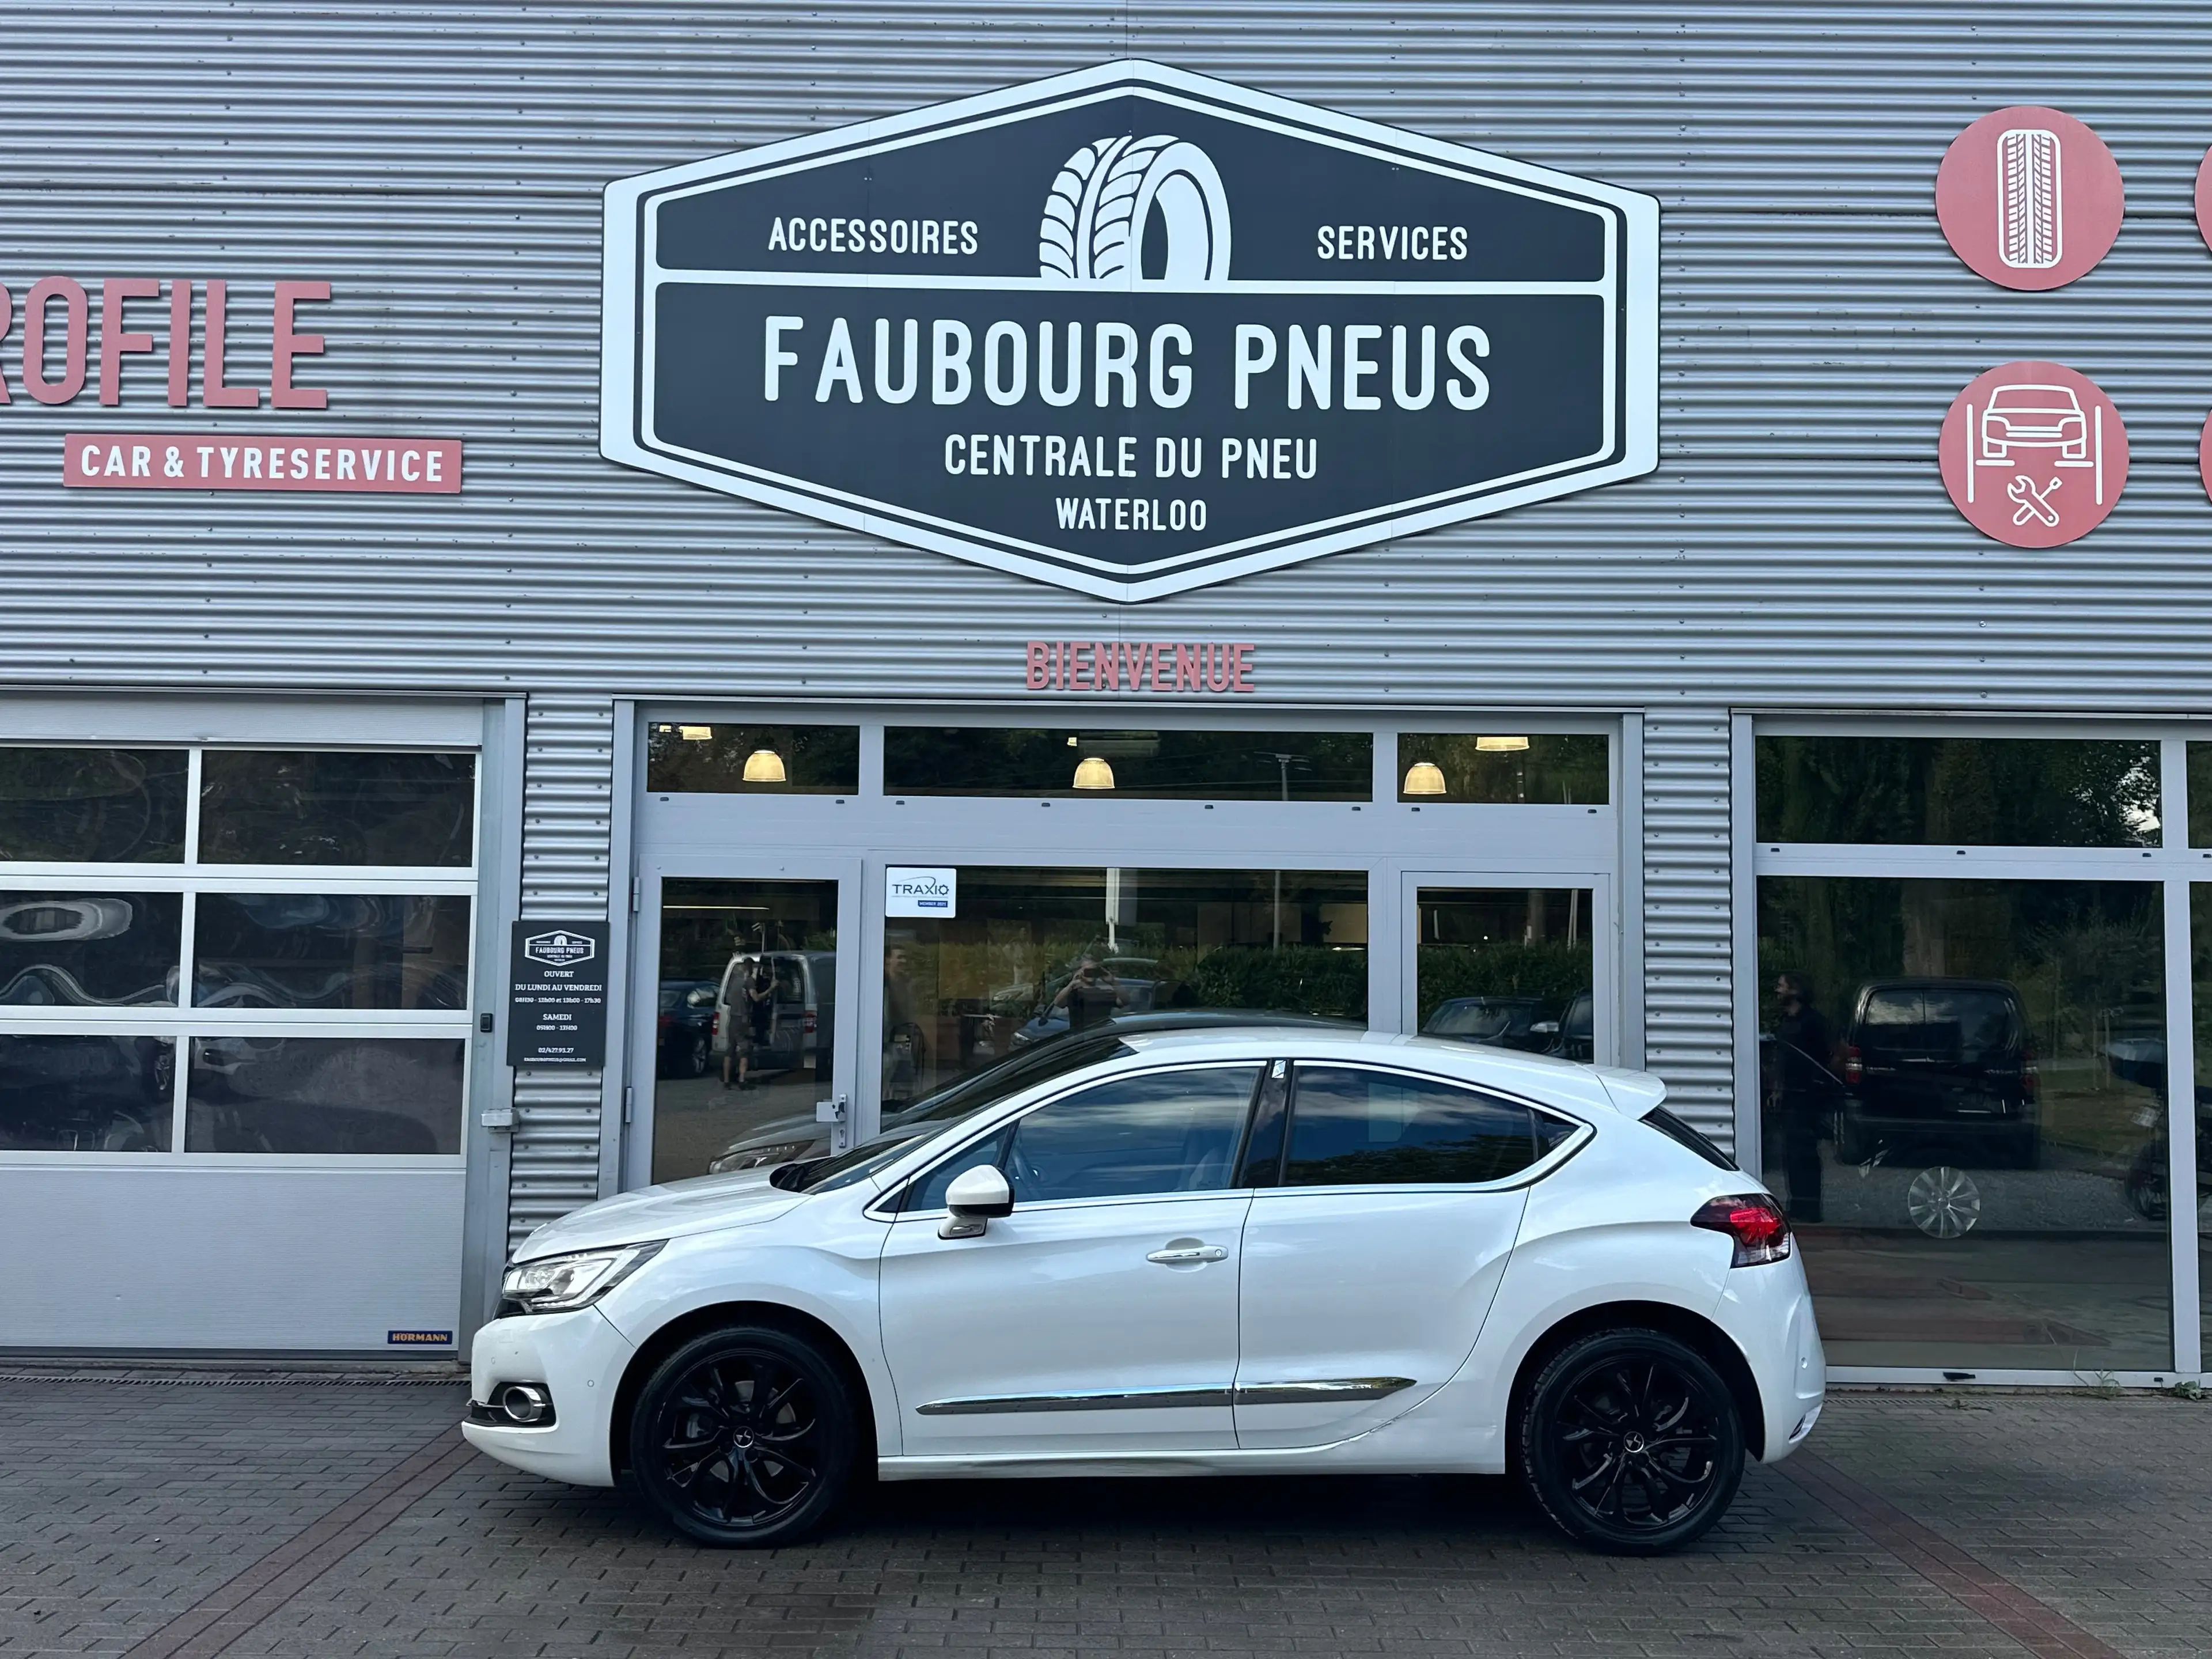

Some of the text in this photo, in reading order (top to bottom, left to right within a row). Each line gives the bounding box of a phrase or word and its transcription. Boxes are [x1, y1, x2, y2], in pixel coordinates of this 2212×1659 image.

[768, 217, 978, 255] ACCESSOIRES
[1317, 225, 1468, 260] SERVICES
[0, 275, 331, 408] OFILE
[764, 316, 1490, 411] FAUBOURG PNEUS
[81, 445, 443, 482] CAR & TYRESERVICE
[945, 434, 1317, 479] CENTRALE DU PNEU
[1055, 497, 1207, 531] WATERLOO
[1027, 641, 1255, 692] BIENVENUE
[892, 883, 949, 895] TRAXIO
